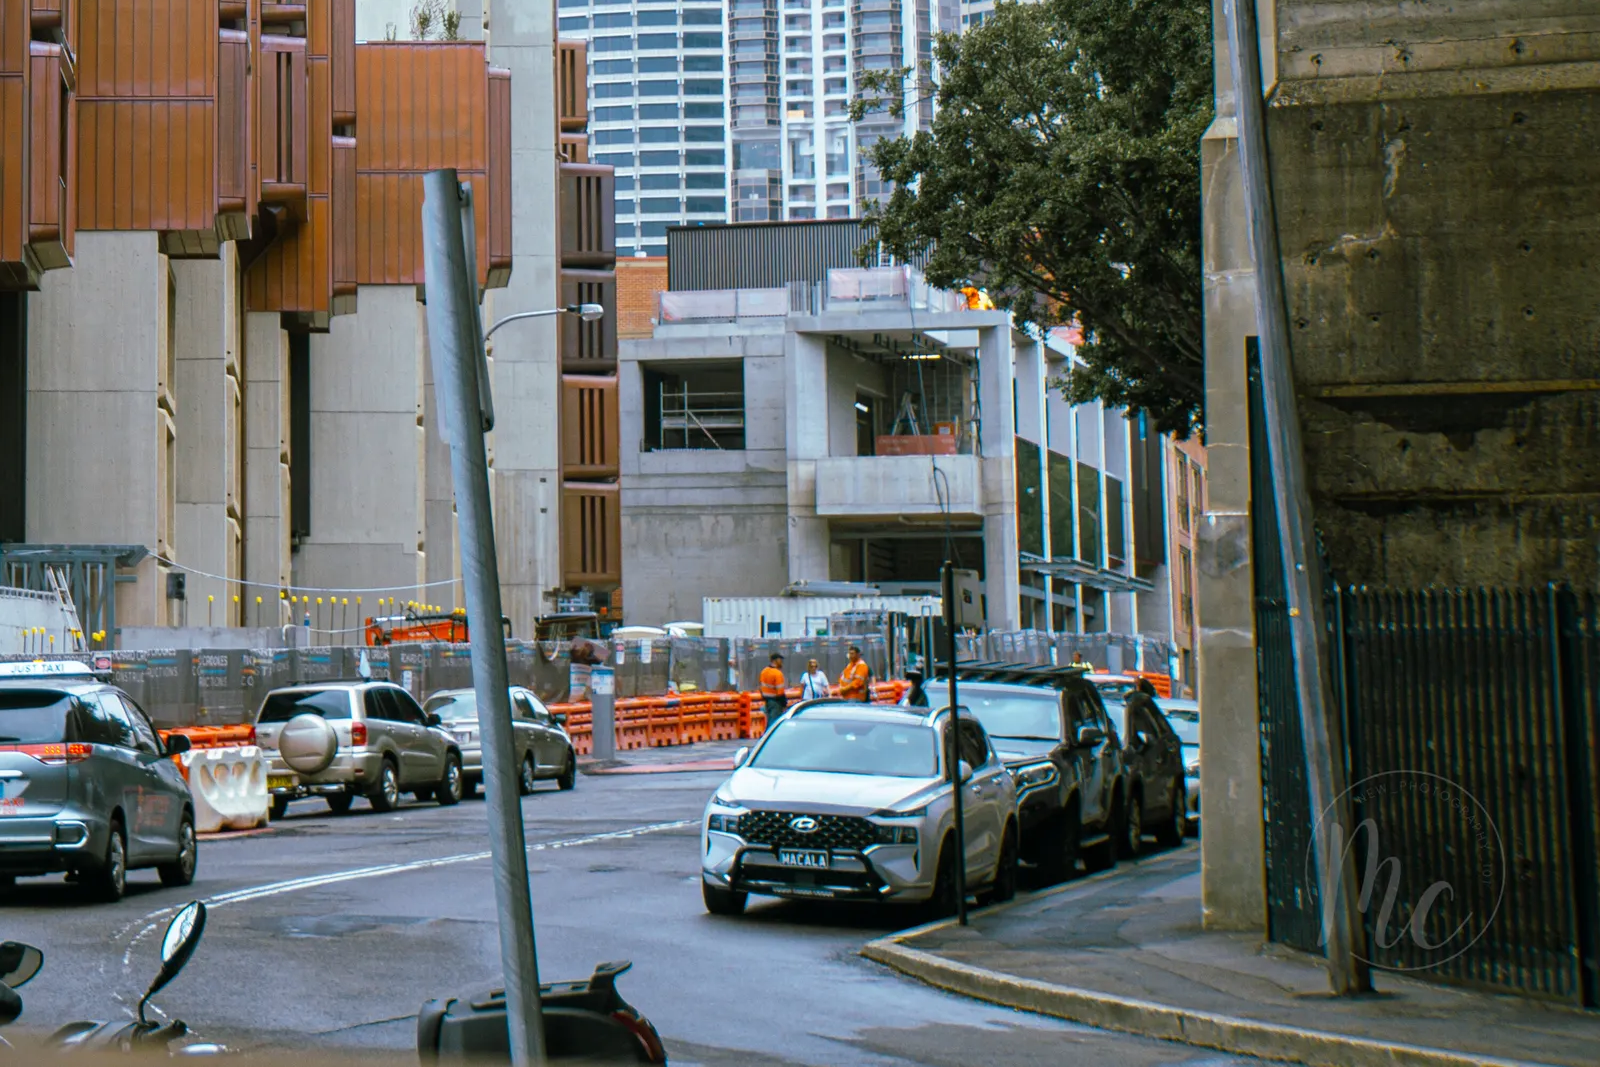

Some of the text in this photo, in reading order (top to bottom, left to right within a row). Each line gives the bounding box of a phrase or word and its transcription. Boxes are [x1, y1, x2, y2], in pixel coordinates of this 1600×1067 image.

[10, 663, 65, 673] JUST TAXI
[781, 852, 827, 868] MACALA
